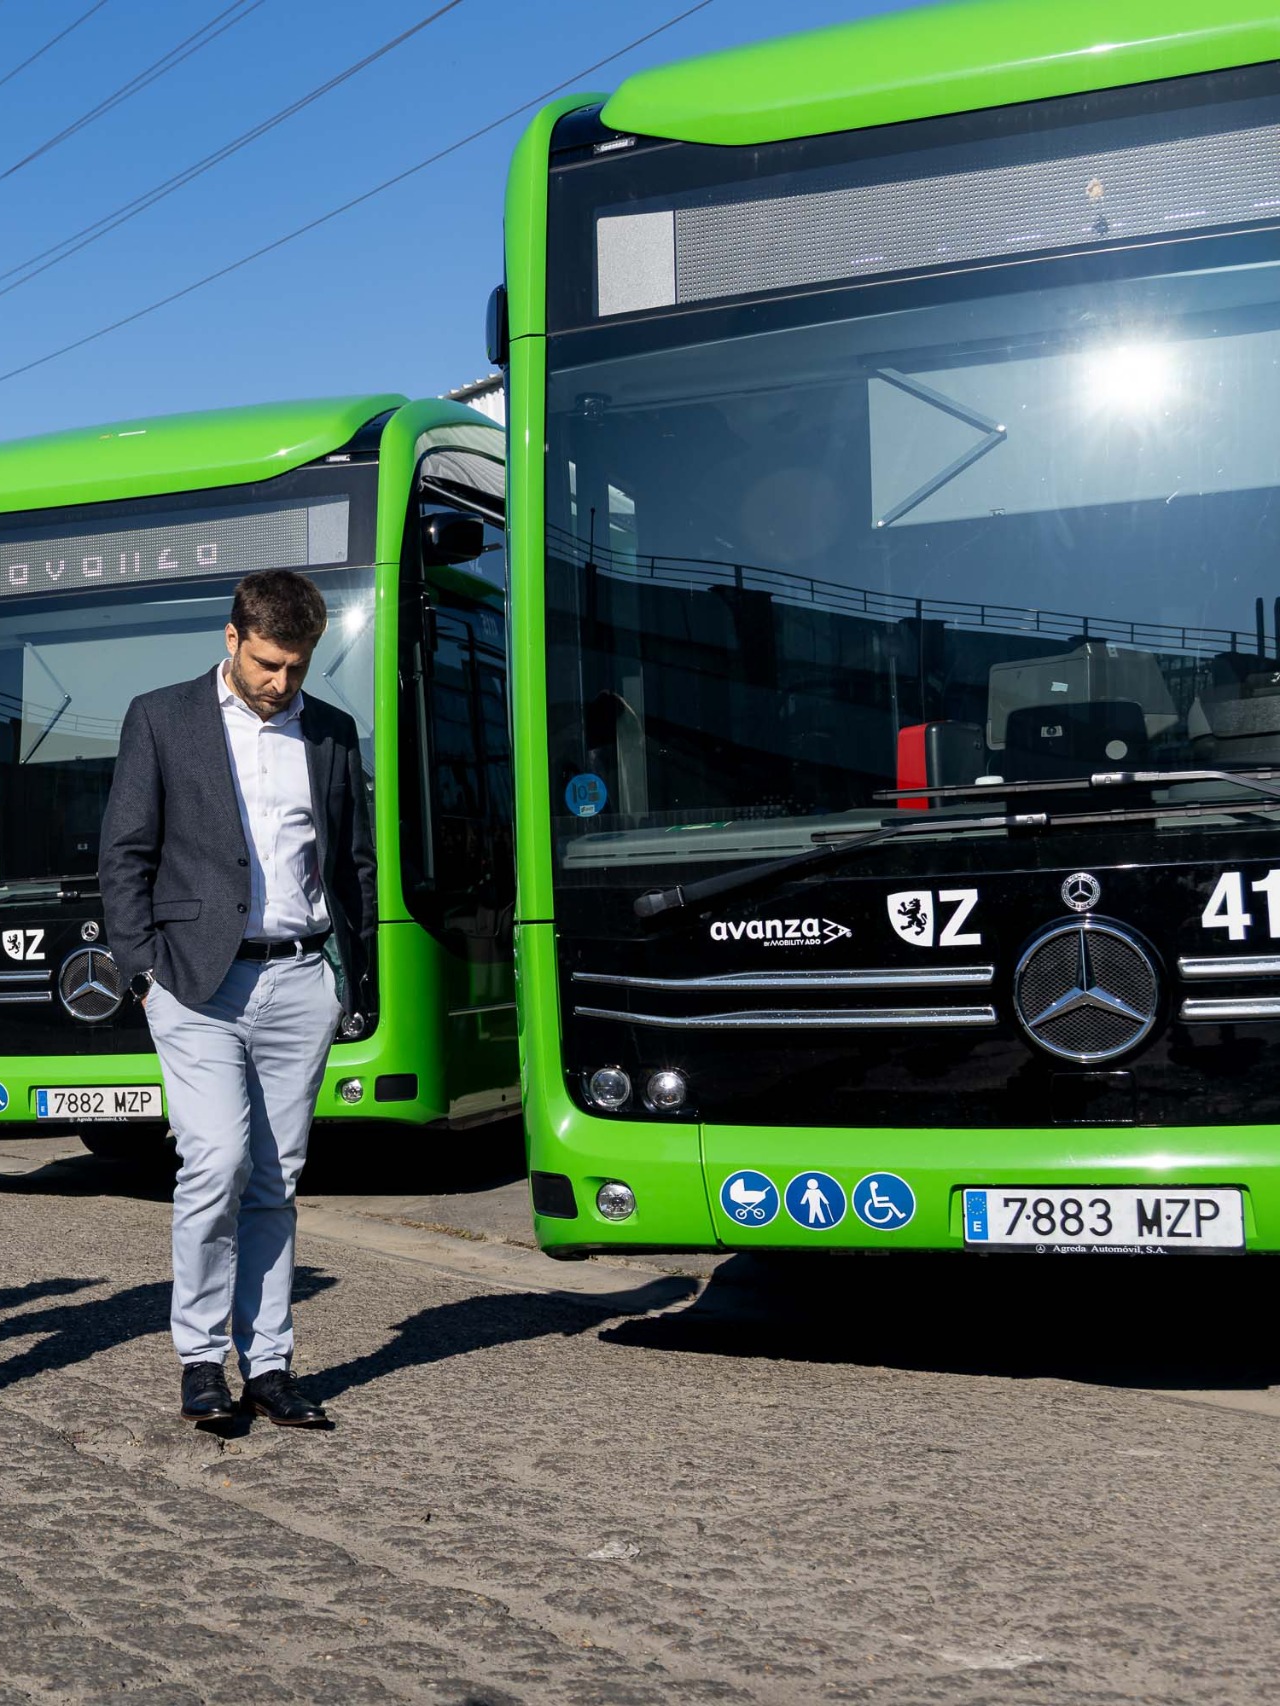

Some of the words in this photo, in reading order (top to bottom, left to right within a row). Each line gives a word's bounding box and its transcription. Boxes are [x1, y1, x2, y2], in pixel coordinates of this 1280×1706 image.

[710, 918, 821, 941] avanza
[770, 939, 804, 947] MOBILITY
[54, 1092, 105, 1114] 7882
[114, 1091, 152, 1113] MZP
[1003, 1197, 1113, 1236] 7883
[1136, 1198, 1220, 1238] MZP
[973, 1221, 982, 1232] E
[1053, 1244, 1087, 1254] Agreda
[1145, 1245, 1167, 1254] S.A.
